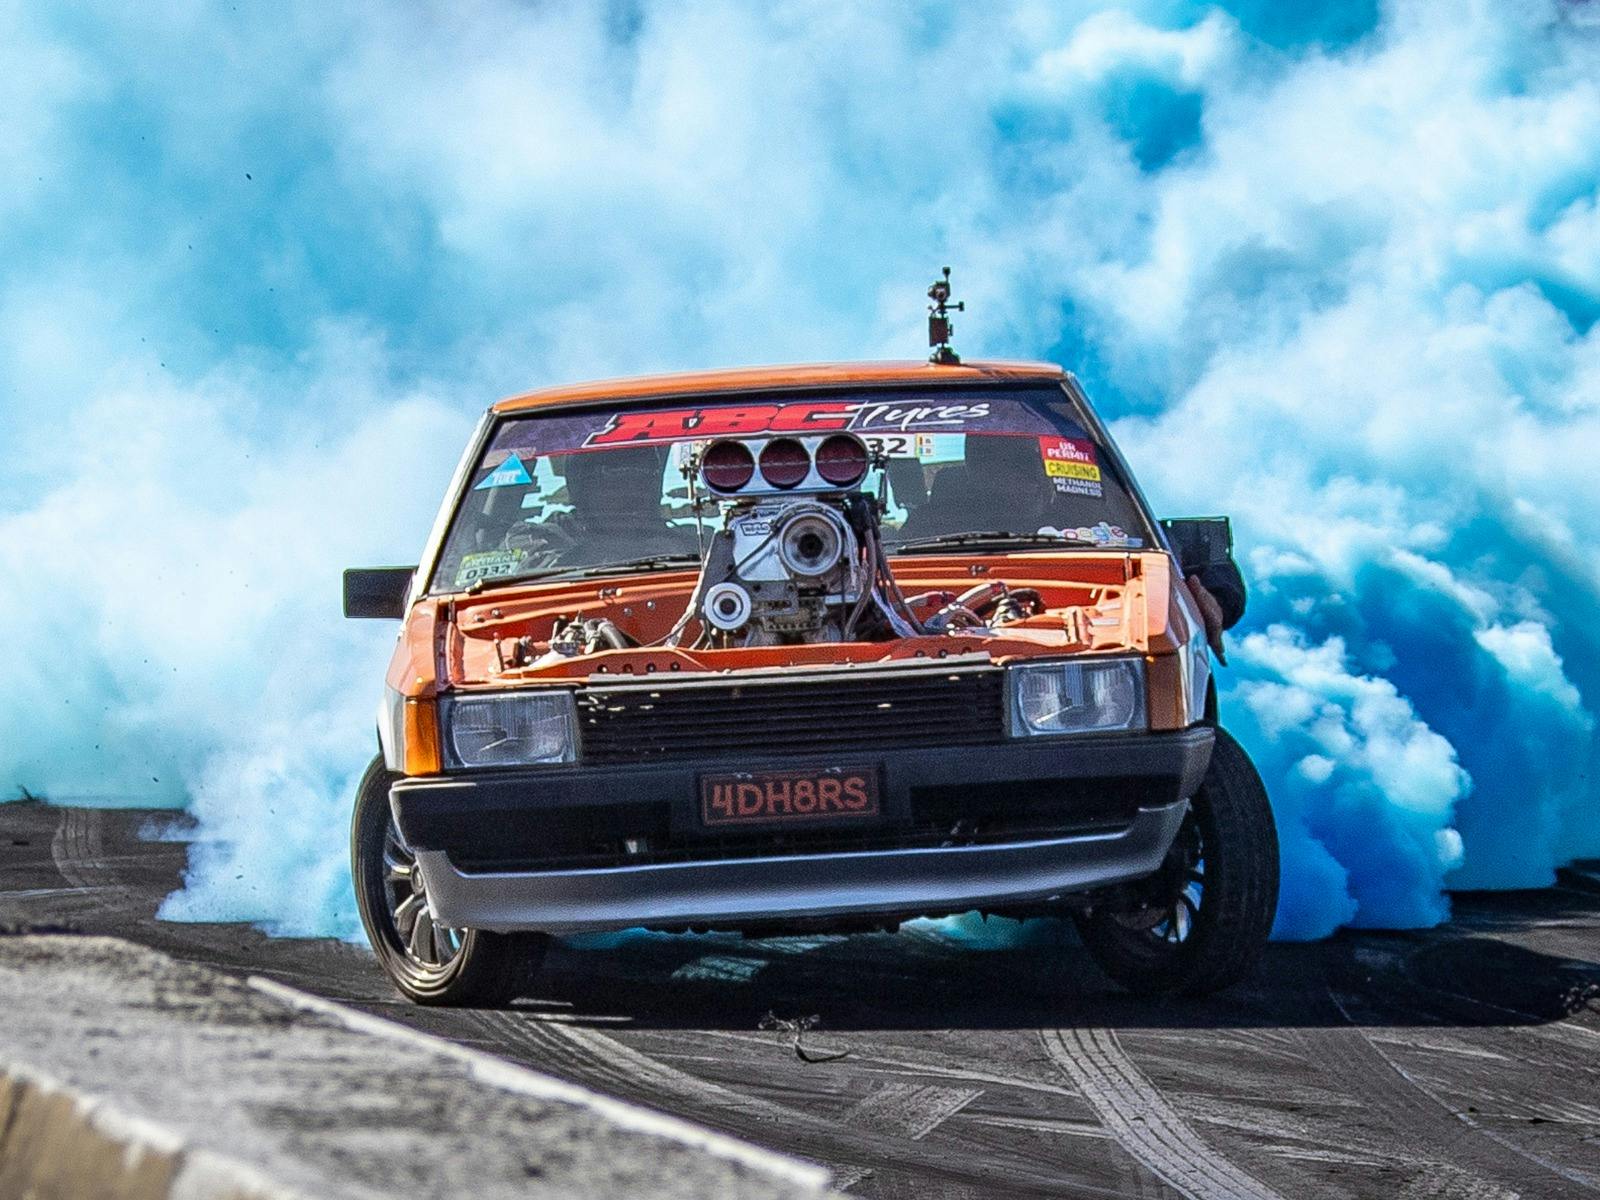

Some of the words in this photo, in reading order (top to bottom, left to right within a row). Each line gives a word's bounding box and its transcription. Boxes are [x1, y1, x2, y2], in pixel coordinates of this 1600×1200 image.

[588, 403, 856, 445] ABC
[846, 400, 990, 430] Tyres
[1047, 448, 1089, 461] PERMIT
[1048, 462, 1098, 478] CRUISING
[711, 776, 868, 817] 4DH8RS
